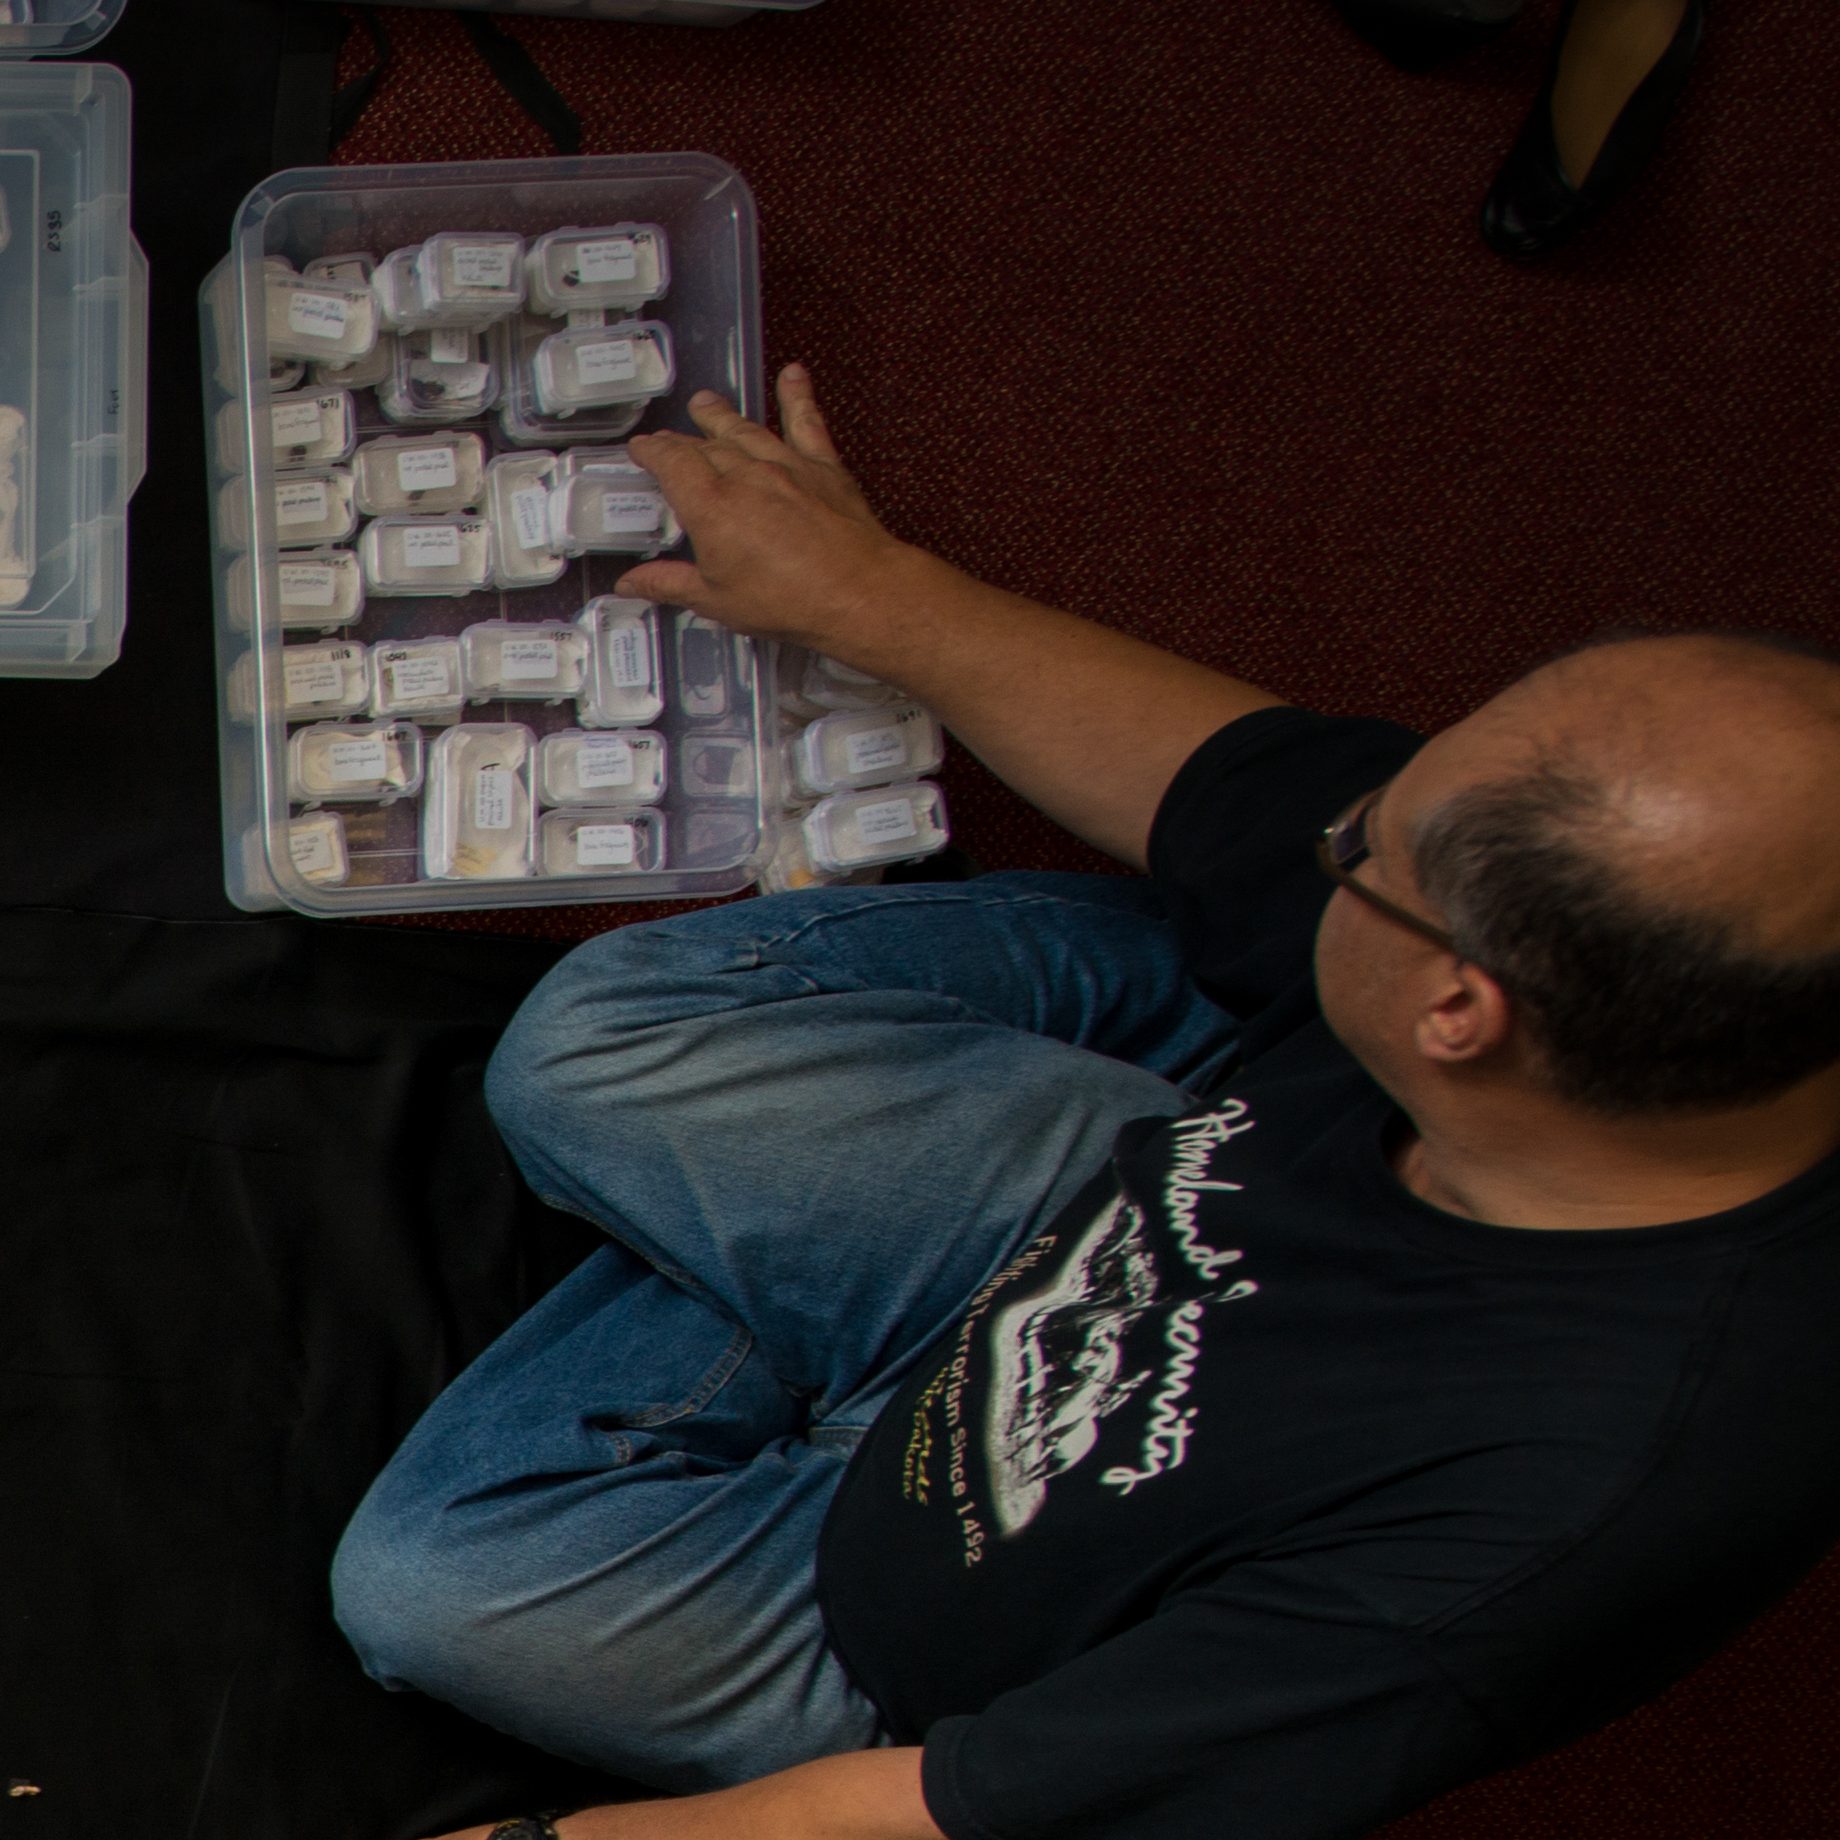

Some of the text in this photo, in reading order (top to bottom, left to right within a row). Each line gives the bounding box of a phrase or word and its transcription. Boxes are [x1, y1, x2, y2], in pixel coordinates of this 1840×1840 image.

[1165, 1098, 1256, 1280] Homeland
[944, 1303, 990, 1427] Terrorism
[947, 1427, 968, 1498] Since
[954, 1501, 986, 1568] 1492
